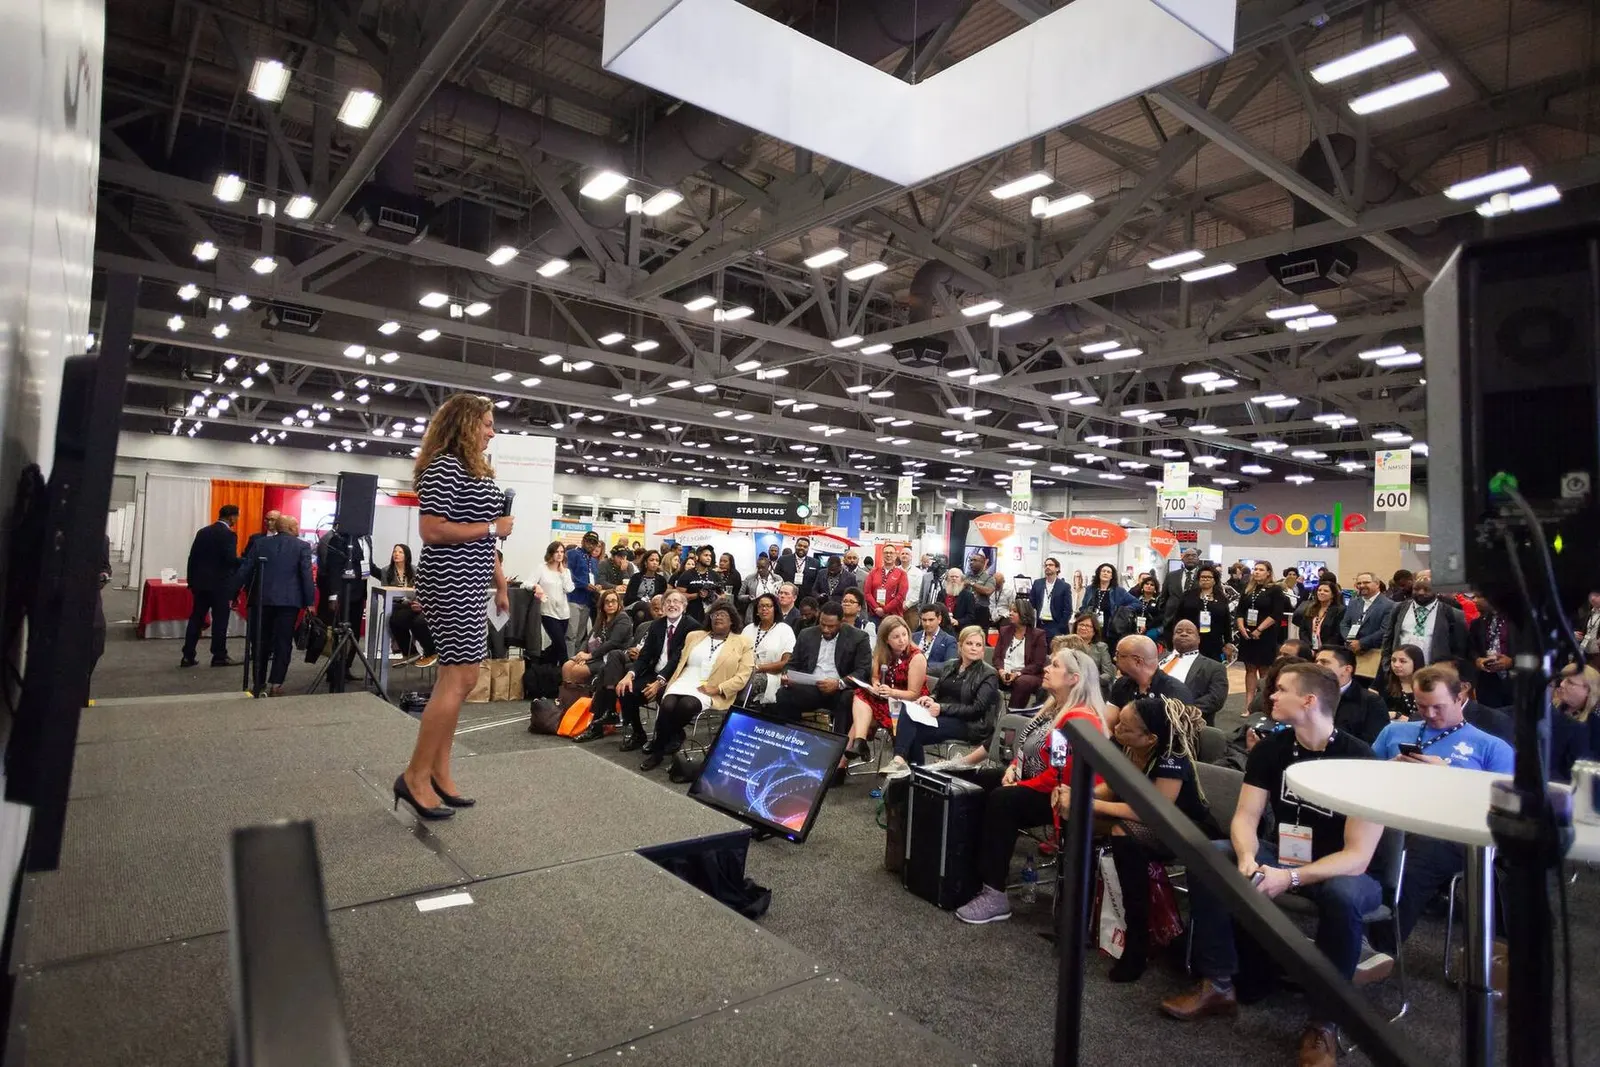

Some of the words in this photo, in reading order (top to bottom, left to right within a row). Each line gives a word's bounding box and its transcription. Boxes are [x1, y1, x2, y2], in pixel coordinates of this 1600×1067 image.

[1012, 501, 1029, 512] 800
[1164, 498, 1186, 511] 700
[1376, 492, 1407, 508] 600
[736, 506, 785, 516] STARBUCKS
[977, 521, 1012, 532] ORACLE
[1229, 502, 1367, 546] Google
[1069, 525, 1109, 539] ORACLE
[1151, 536, 1176, 545] ORACLE
[754, 726, 765, 735] Tech
[765, 730, 776, 738] HUB
[775, 732, 786, 741] Run
[790, 736, 806, 746] Show
